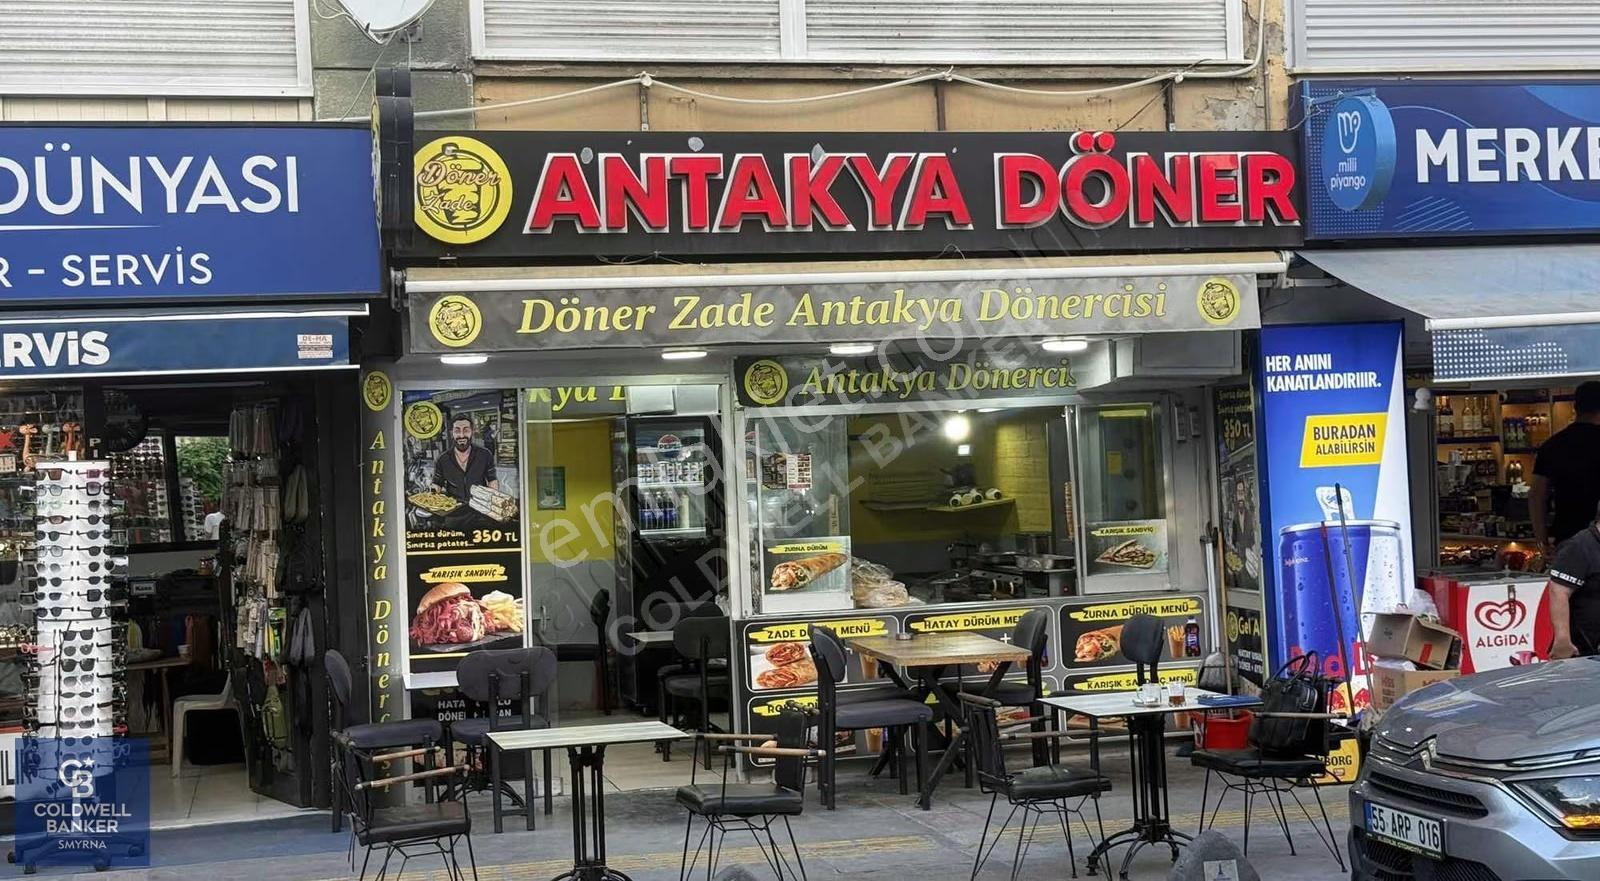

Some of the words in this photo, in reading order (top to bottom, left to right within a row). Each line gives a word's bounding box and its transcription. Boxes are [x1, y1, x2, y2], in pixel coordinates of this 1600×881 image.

[418, 161, 501, 188] Döner
[1337, 157, 1357, 174] milli
[522, 152, 975, 235] ANTAKYA
[994, 130, 1301, 230] DÖNER
[1330, 173, 1366, 191] piyango
[420, 190, 479, 215] Zade
[61, 246, 213, 287] SERVİS
[516, 297, 656, 335] Döner
[668, 292, 774, 330] Zade
[785, 287, 964, 331] Antakya
[977, 282, 1168, 323] Dönercisi
[1265, 354, 1291, 372] HER
[1295, 352, 1332, 372] ANINI
[799, 364, 936, 399] Antakya
[1266, 369, 1382, 393] KANATLANDIRIIIR.
[1224, 419, 1241, 438] 350
[1313, 424, 1376, 441] BURADAN
[1315, 438, 1376, 456] ALABİLİRSİN
[368, 430, 388, 581] Antakya
[472, 529, 502, 544] 350
[505, 532, 519, 543] TL
[431, 570, 464, 580] KARIŞIK
[1083, 608, 1118, 619] ZURNA
[1121, 604, 1157, 617] DÜRÜM
[1160, 602, 1189, 614] MENÜ
[840, 622, 871, 635] MENÜ
[923, 619, 960, 630] HATAY
[963, 614, 1000, 627] DÜRÜM
[767, 630, 796, 640] ZADE
[1087, 679, 1122, 691] KARIŞIK
[438, 699, 466, 710] HATA
[1371, 806, 1387, 833] 55
[1391, 812, 1412, 840] ARP
[1417, 819, 1440, 850] 016
